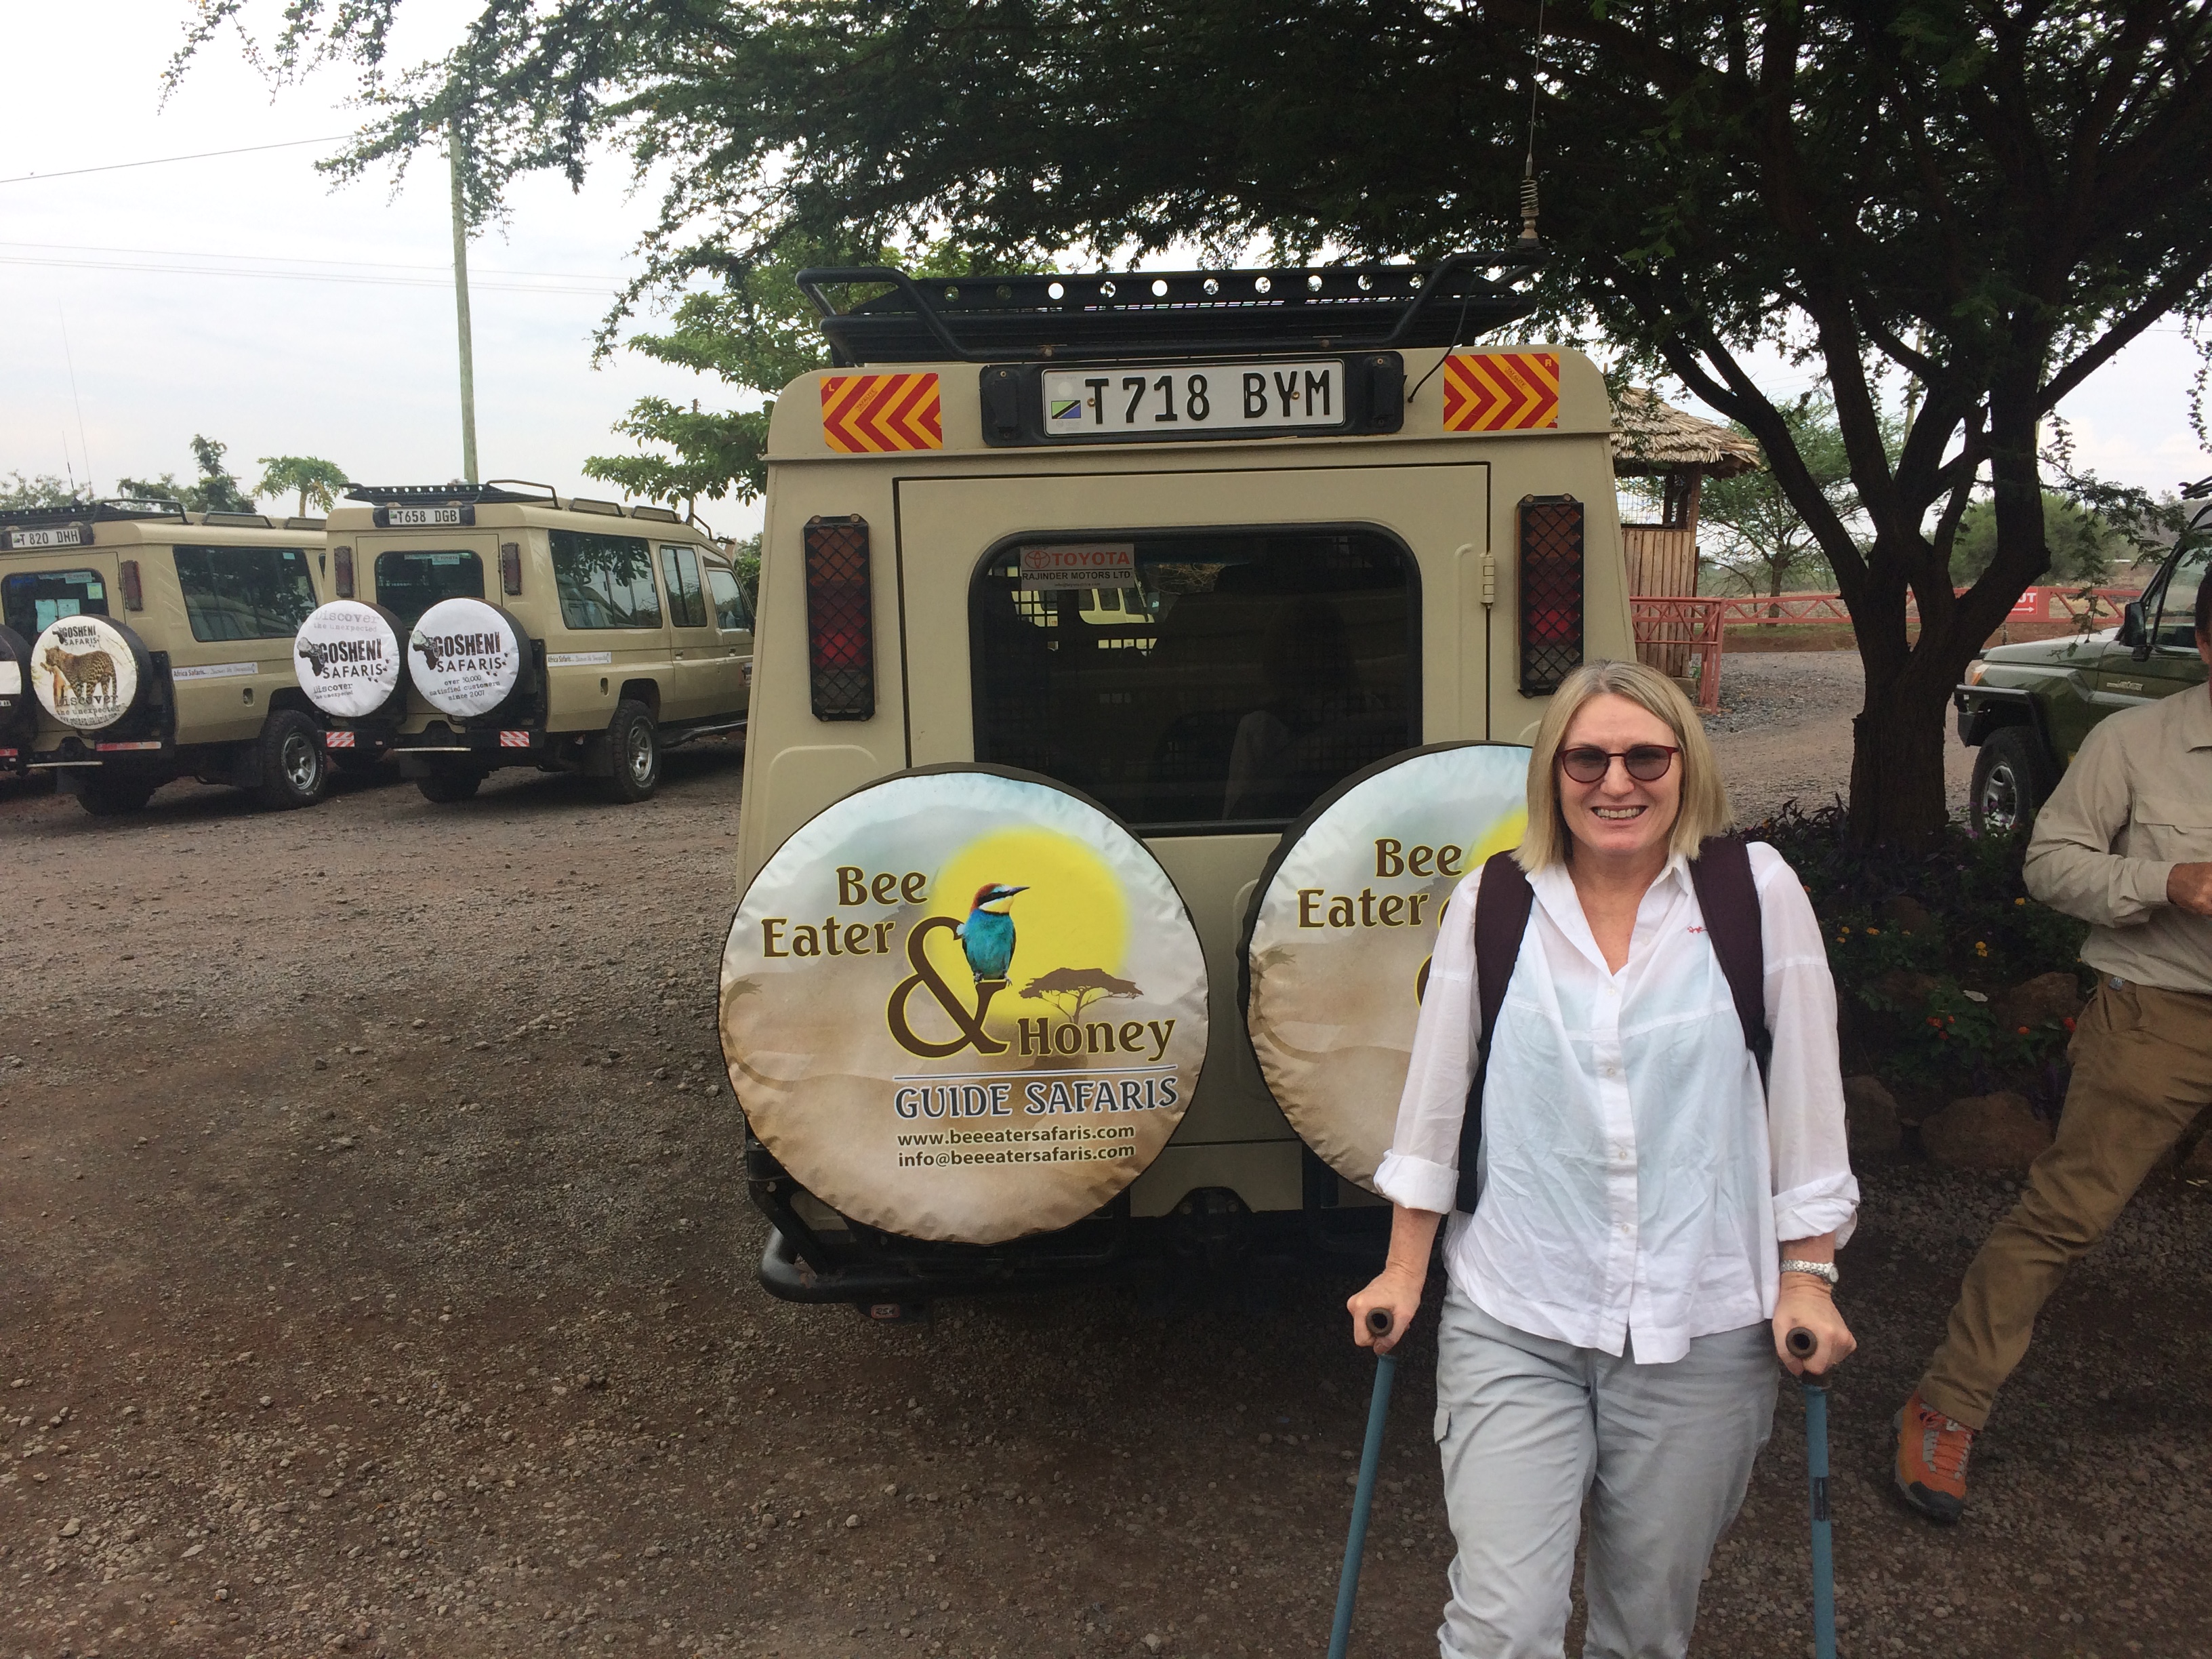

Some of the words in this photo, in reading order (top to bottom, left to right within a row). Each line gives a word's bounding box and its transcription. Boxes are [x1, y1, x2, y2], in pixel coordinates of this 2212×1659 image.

[1244, 369, 1330, 419] BYM
[434, 510, 457, 523] DGB
[56, 530, 79, 543] DNH
[1052, 551, 1130, 567] TOYOTA
[1022, 572, 1069, 581] RAJINDER
[1071, 571, 1111, 580] MOTORS
[2018, 592, 2036, 603] UT
[314, 611, 380, 623] Discover
[62, 626, 96, 638] GOSHENI
[330, 624, 377, 632] unexpected
[64, 637, 98, 646] SAFARIS
[434, 632, 501, 657] GOSHENI
[319, 638, 382, 663] GOSHENI
[322, 663, 383, 678] SAFARIS
[437, 657, 502, 673] SAFARIS
[314, 683, 353, 694] Discover
[429, 687, 461, 696] satisfied
[464, 680, 501, 691] customers
[470, 690, 485, 698] 2007
[57, 695, 119, 706] Discover
[72, 705, 121, 717] unexpected
[1374, 838, 1463, 878] Bee
[836, 866, 928, 907] Bee
[1298, 888, 1429, 928] Eater
[760, 916, 895, 958] Eater
[1017, 1017, 1176, 1061] Honey
[895, 1084, 1011, 1119] GUIDE
[1025, 1076, 1178, 1114] SAFARIS
[897, 1125, 1135, 1146] www.beeeatersafaris.com
[898, 1144, 1135, 1168] info@beeeatersafaris.com
